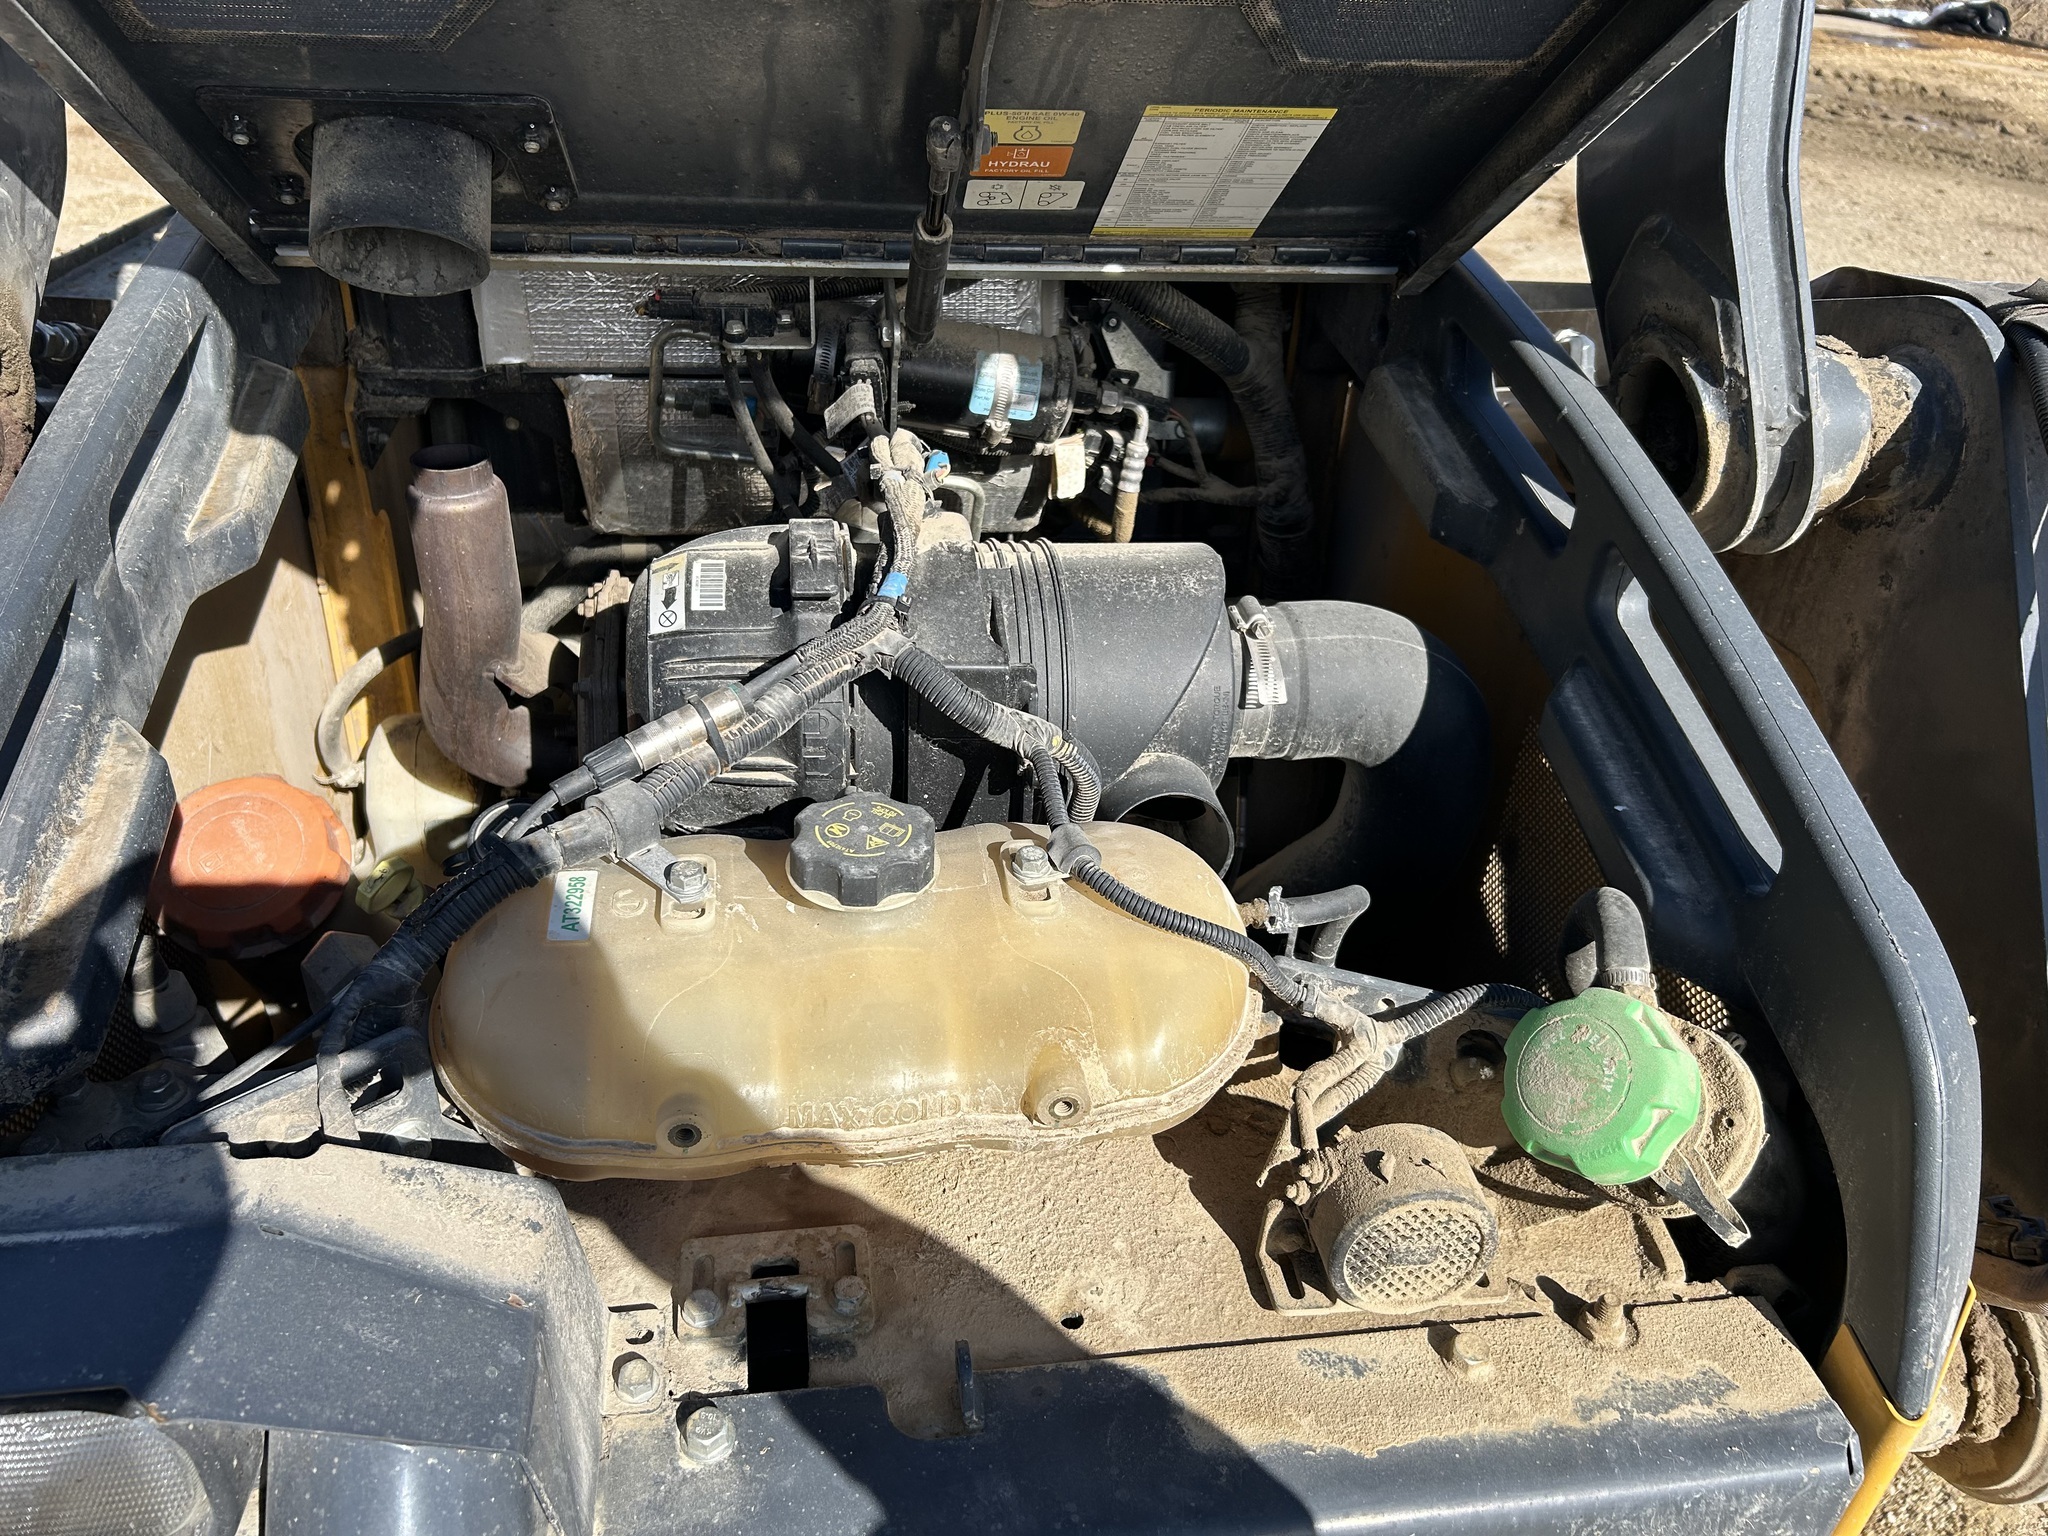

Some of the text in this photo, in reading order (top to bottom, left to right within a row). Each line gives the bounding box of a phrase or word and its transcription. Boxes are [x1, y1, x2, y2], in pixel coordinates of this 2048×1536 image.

[1213, 685, 1221, 720] TORQUE
[561, 876, 587, 932] AT322958
[788, 1094, 963, 1129] MAX COLD
